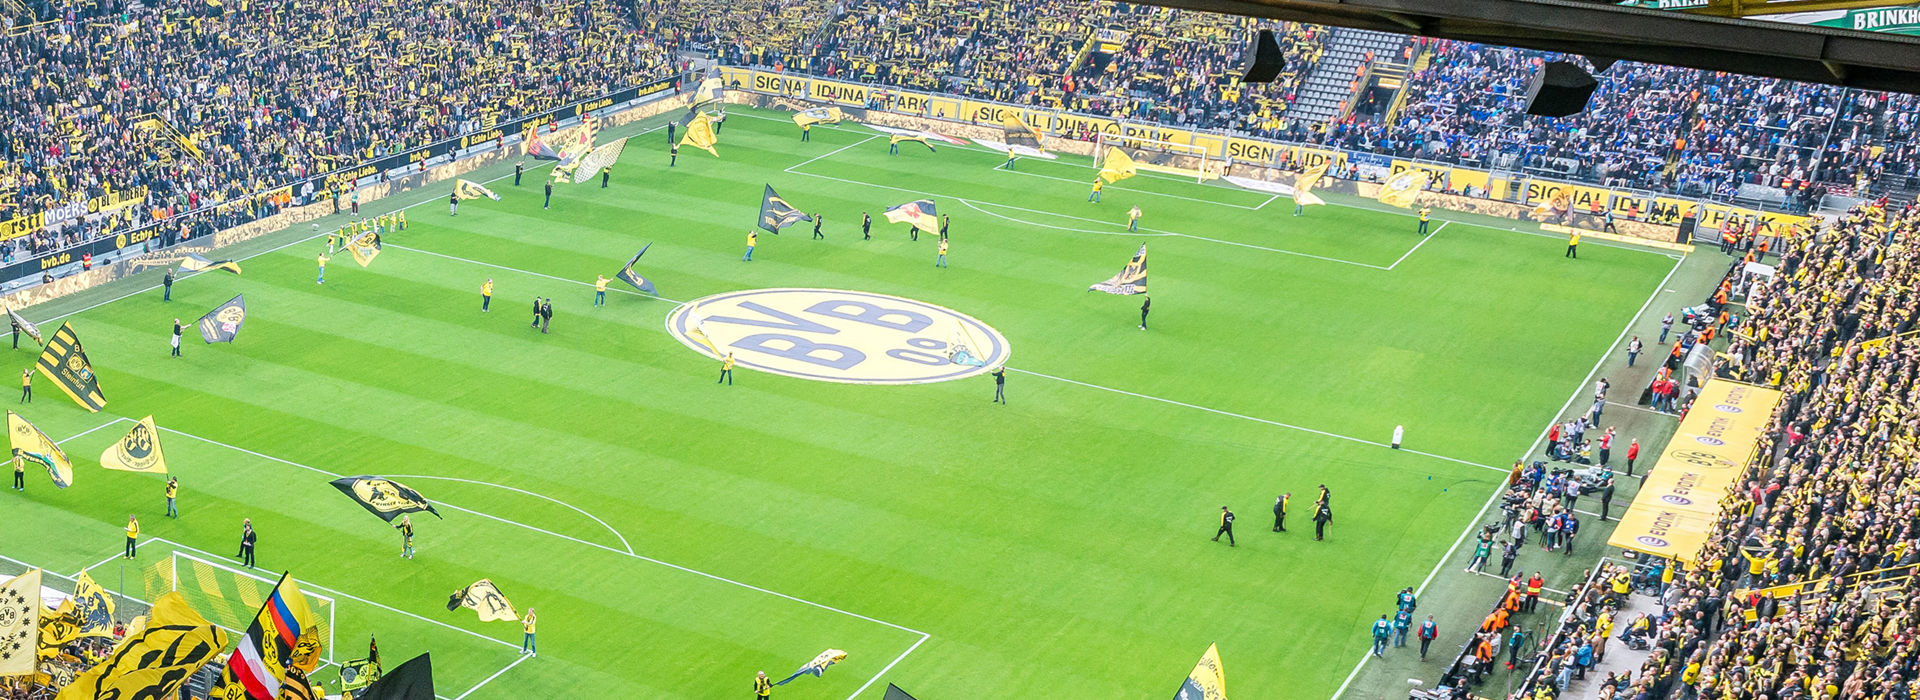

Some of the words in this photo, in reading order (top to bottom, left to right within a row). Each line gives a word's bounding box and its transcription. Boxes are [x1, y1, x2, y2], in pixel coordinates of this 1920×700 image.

[1854, 9, 1920, 29] BRINKH
[816, 84, 865, 103] IDUNA
[1230, 143, 1297, 165] SIGNL
[1393, 165, 1446, 185] PRK
[45, 202, 88, 224] MOERS
[41, 252, 71, 269] bvb.de
[61, 368, 86, 391] Steinfurt
[1649, 511, 1677, 536] EVONIK
